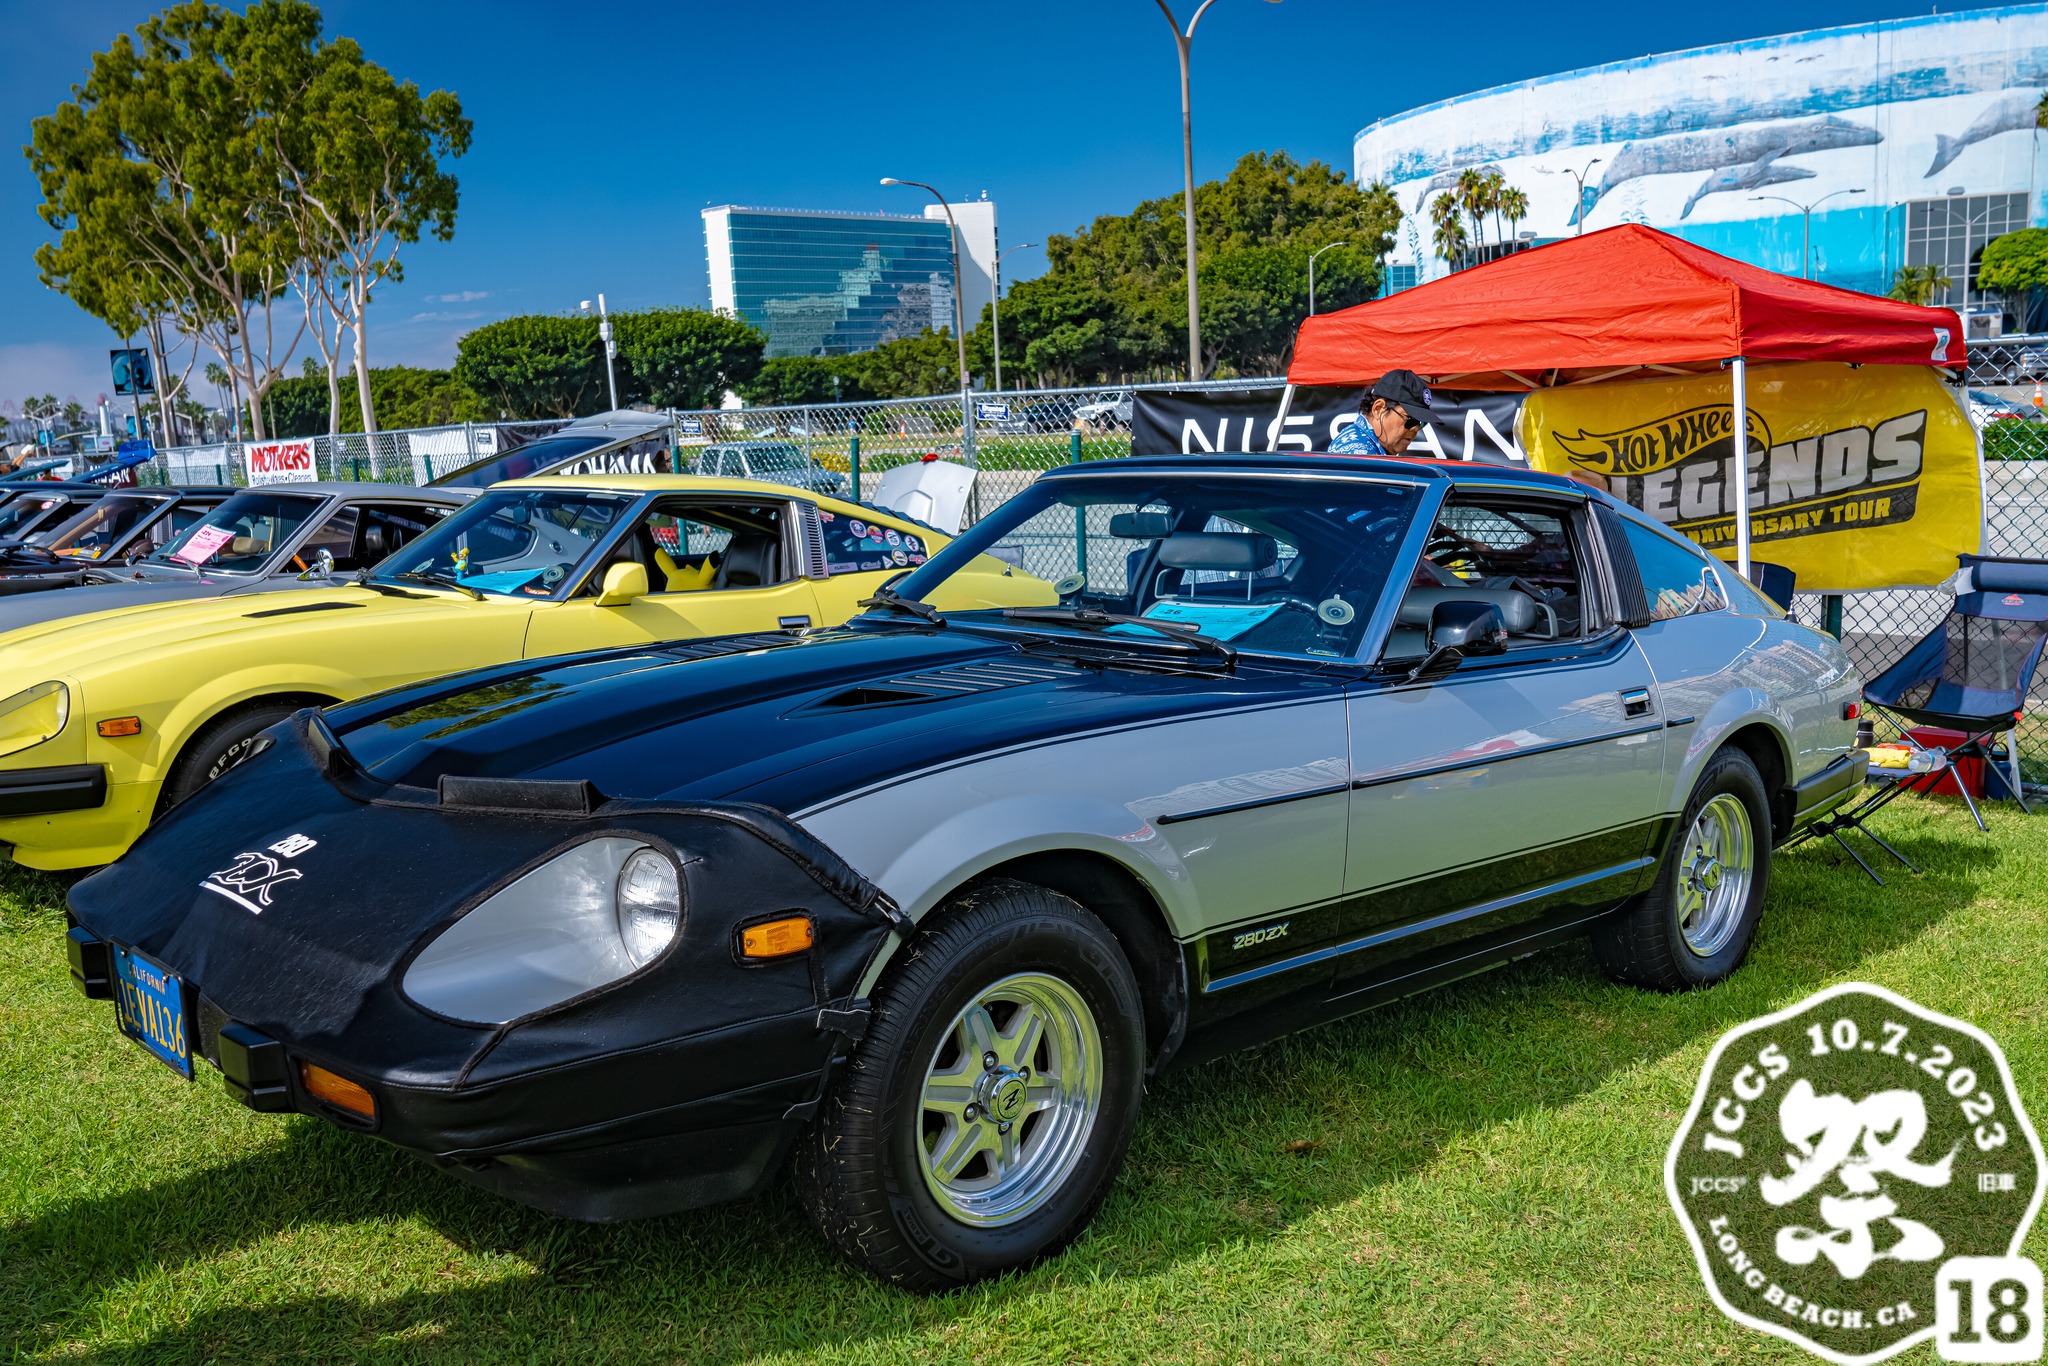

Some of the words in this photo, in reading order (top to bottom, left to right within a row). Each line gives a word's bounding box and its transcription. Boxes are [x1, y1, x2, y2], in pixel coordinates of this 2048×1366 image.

[251, 442, 311, 472] MOTHERS
[1677, 509, 1824, 545] NNIVRSARY
[1830, 497, 1891, 523] TOUR
[1231, 921, 1290, 950] 280ZX
[127, 961, 166, 996] CALIFORNIA
